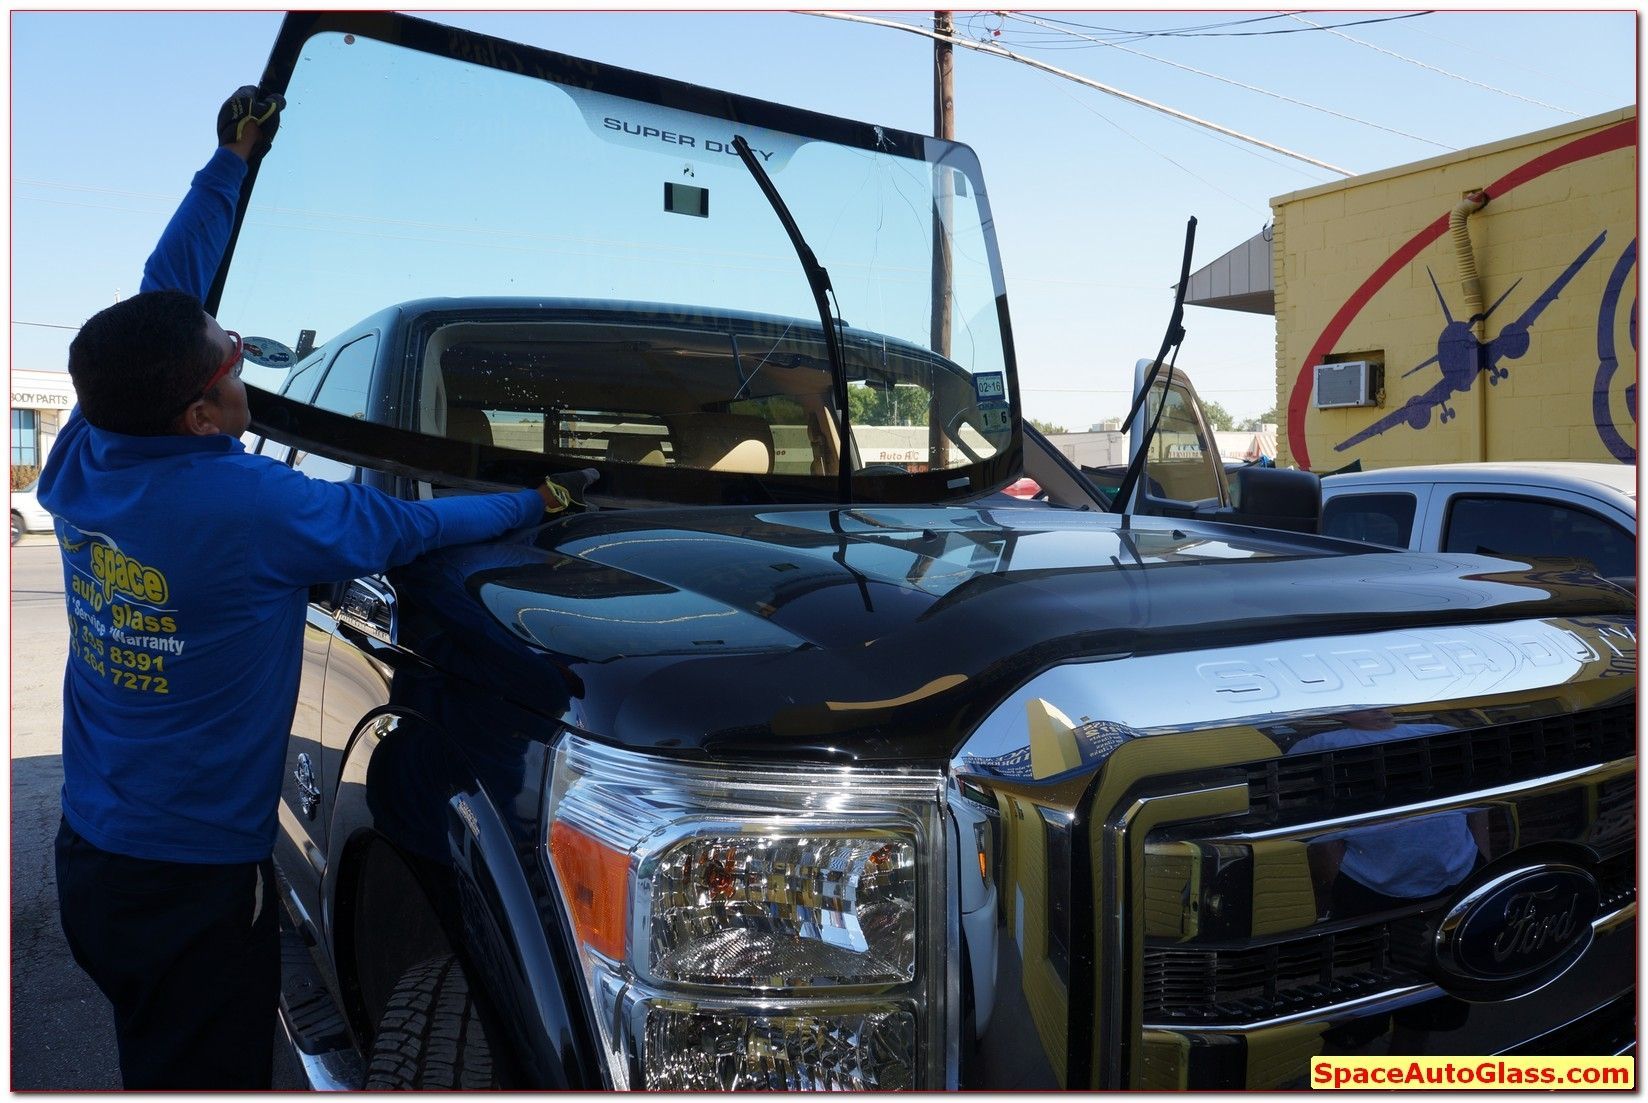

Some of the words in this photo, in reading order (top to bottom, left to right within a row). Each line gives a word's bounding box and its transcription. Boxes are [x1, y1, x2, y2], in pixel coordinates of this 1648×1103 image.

[603, 117, 695, 148] SUPER
[704, 139, 774, 161] DUY
[36, 394, 68, 405] PARTS
[880, 451, 902, 461] Auto
[91, 542, 168, 604] space
[72, 574, 103, 612] auto
[112, 604, 177, 633] glass
[110, 646, 164, 672] 8391
[110, 668, 169, 694] 7272
[1196, 640, 1502, 704] SUPER
[1493, 884, 1580, 962] Ford
